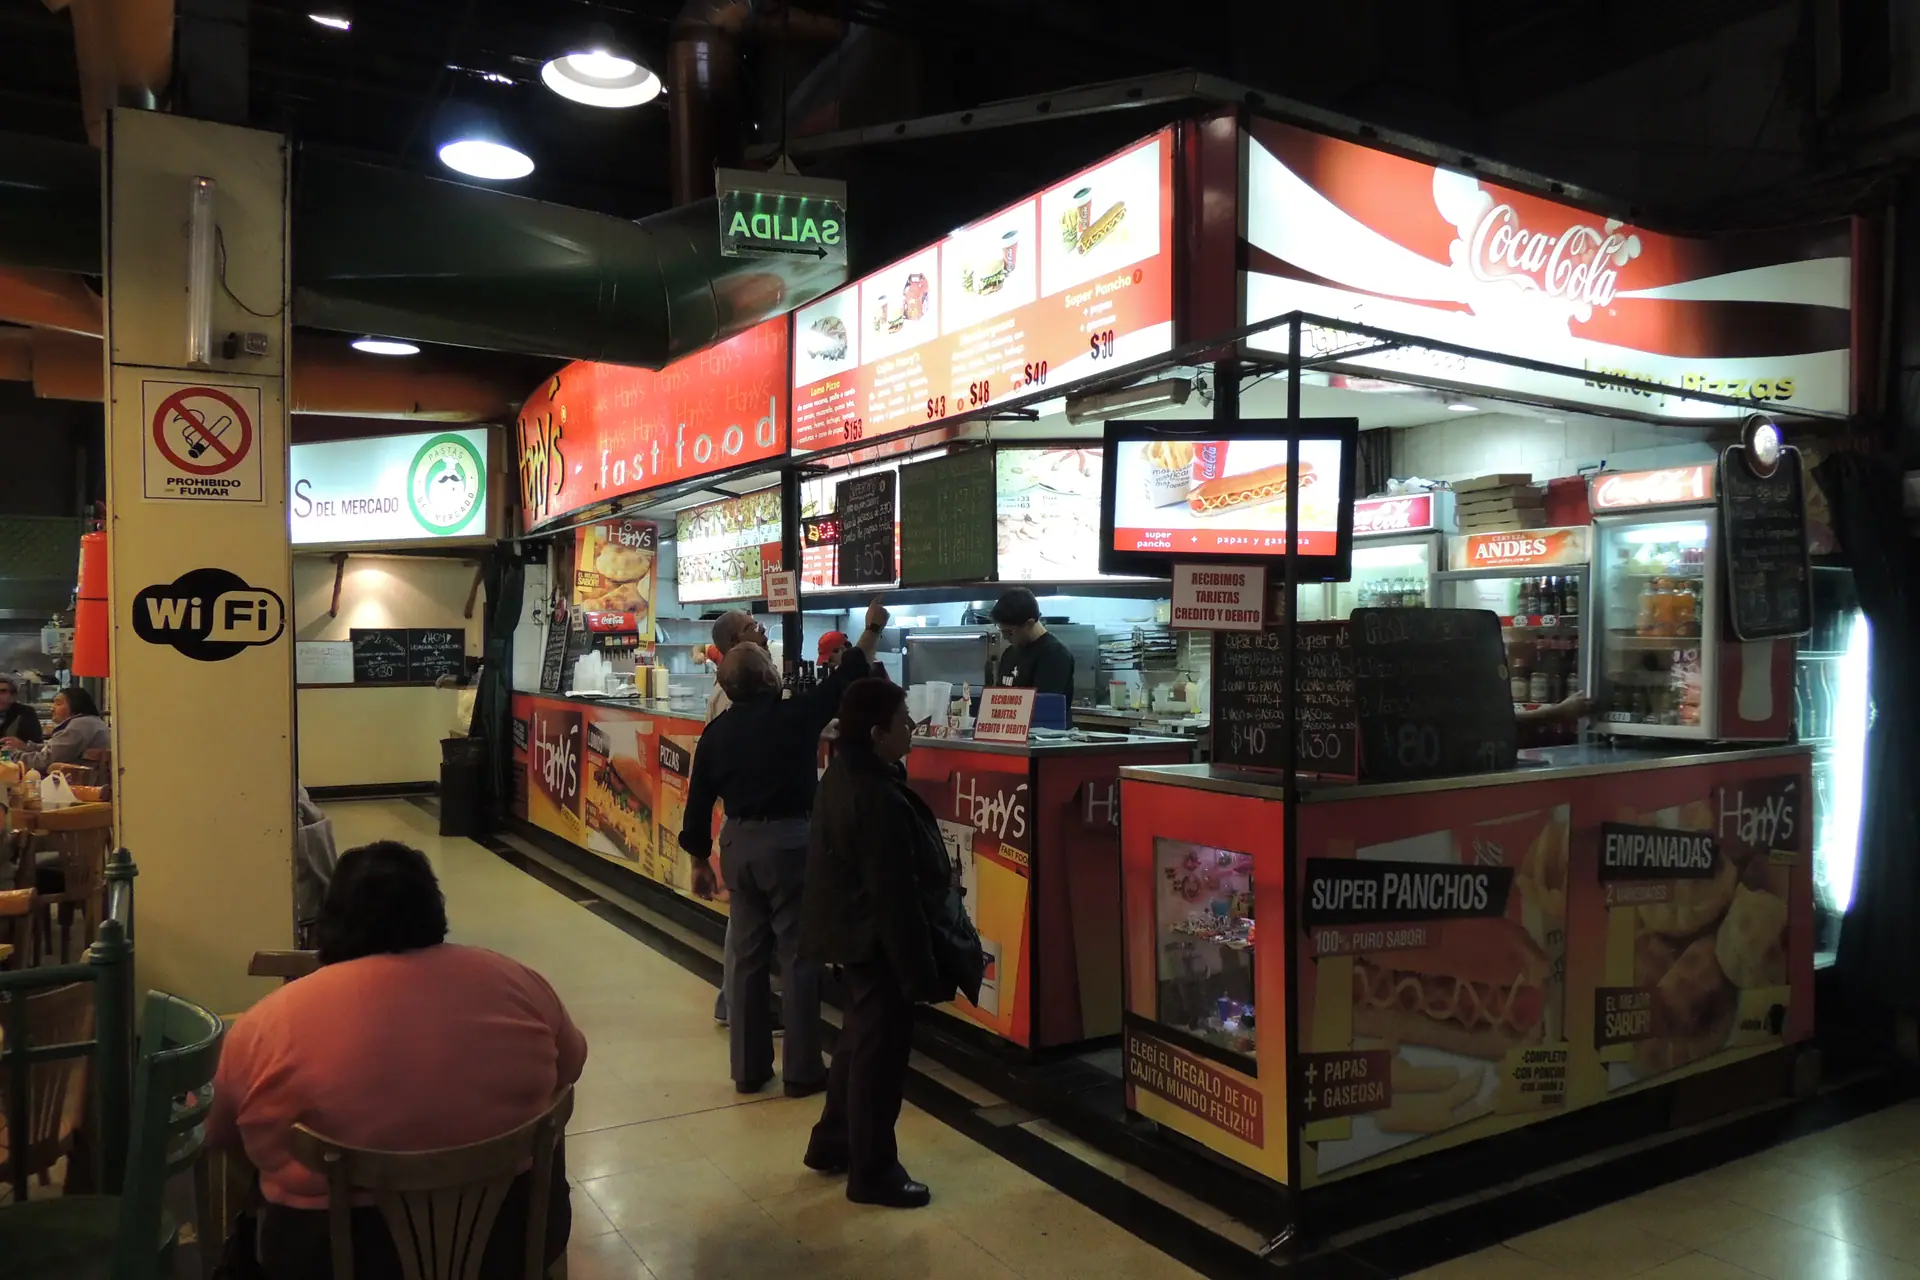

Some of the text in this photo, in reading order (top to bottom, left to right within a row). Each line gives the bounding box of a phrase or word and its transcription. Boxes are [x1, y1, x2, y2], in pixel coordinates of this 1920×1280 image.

[1471, 204, 1622, 306] Coca-Cola
[1091, 329, 1113, 360] $30
[1025, 360, 1047, 386] $40
[970, 380, 989, 406] $48
[1681, 372, 1796, 402] Pizzas
[927, 394, 946, 419] $43
[844, 418, 862, 441] $153
[601, 396, 777, 490] fast food
[166, 476, 241, 489] PROHIBIDO
[179, 486, 229, 498] FUMAR
[294, 479, 399, 518] S DEL MERCADO
[609, 525, 653, 548] Harry's
[1137, 540, 1171, 548] pancho
[1145, 531, 1172, 540] super
[1217, 536, 1248, 545] papas
[1253, 538, 1259, 546] y
[1492, 534, 1526, 542] CERVEZA
[1475, 538, 1547, 559] ANDES
[1191, 572, 1245, 587] RECIBIMOS
[1196, 590, 1240, 604] TARJETAS
[1175, 607, 1260, 623] CREDITO Y DEBITO
[991, 694, 1023, 706] RECIBIMOS
[991, 709, 1017, 720] TARJETAS
[977, 722, 1027, 735] CREDITO Y DEBITO
[1231, 724, 1265, 755] $40
[535, 712, 578, 800] Harry's
[660, 743, 680, 772] PIZZAS
[955, 772, 1028, 839] Harry's
[1719, 782, 1795, 847] Harry's
[1001, 845, 1014, 860] FAST
[1605, 834, 1712, 869] EMPANADAS
[1312, 873, 1488, 910] SUPER PANCHOS
[1315, 928, 1427, 953] 100% PURO SABOR!
[1605, 996, 1617, 1011] EL
[1130, 1036, 1257, 1118] ELEGÍ EL REGALO DE TU
[1324, 1059, 1367, 1080] PAPAS
[1130, 1057, 1255, 1139] CAJITA MUNDO FELIZ!!!
[1324, 1083, 1384, 1108] GASEOSA
